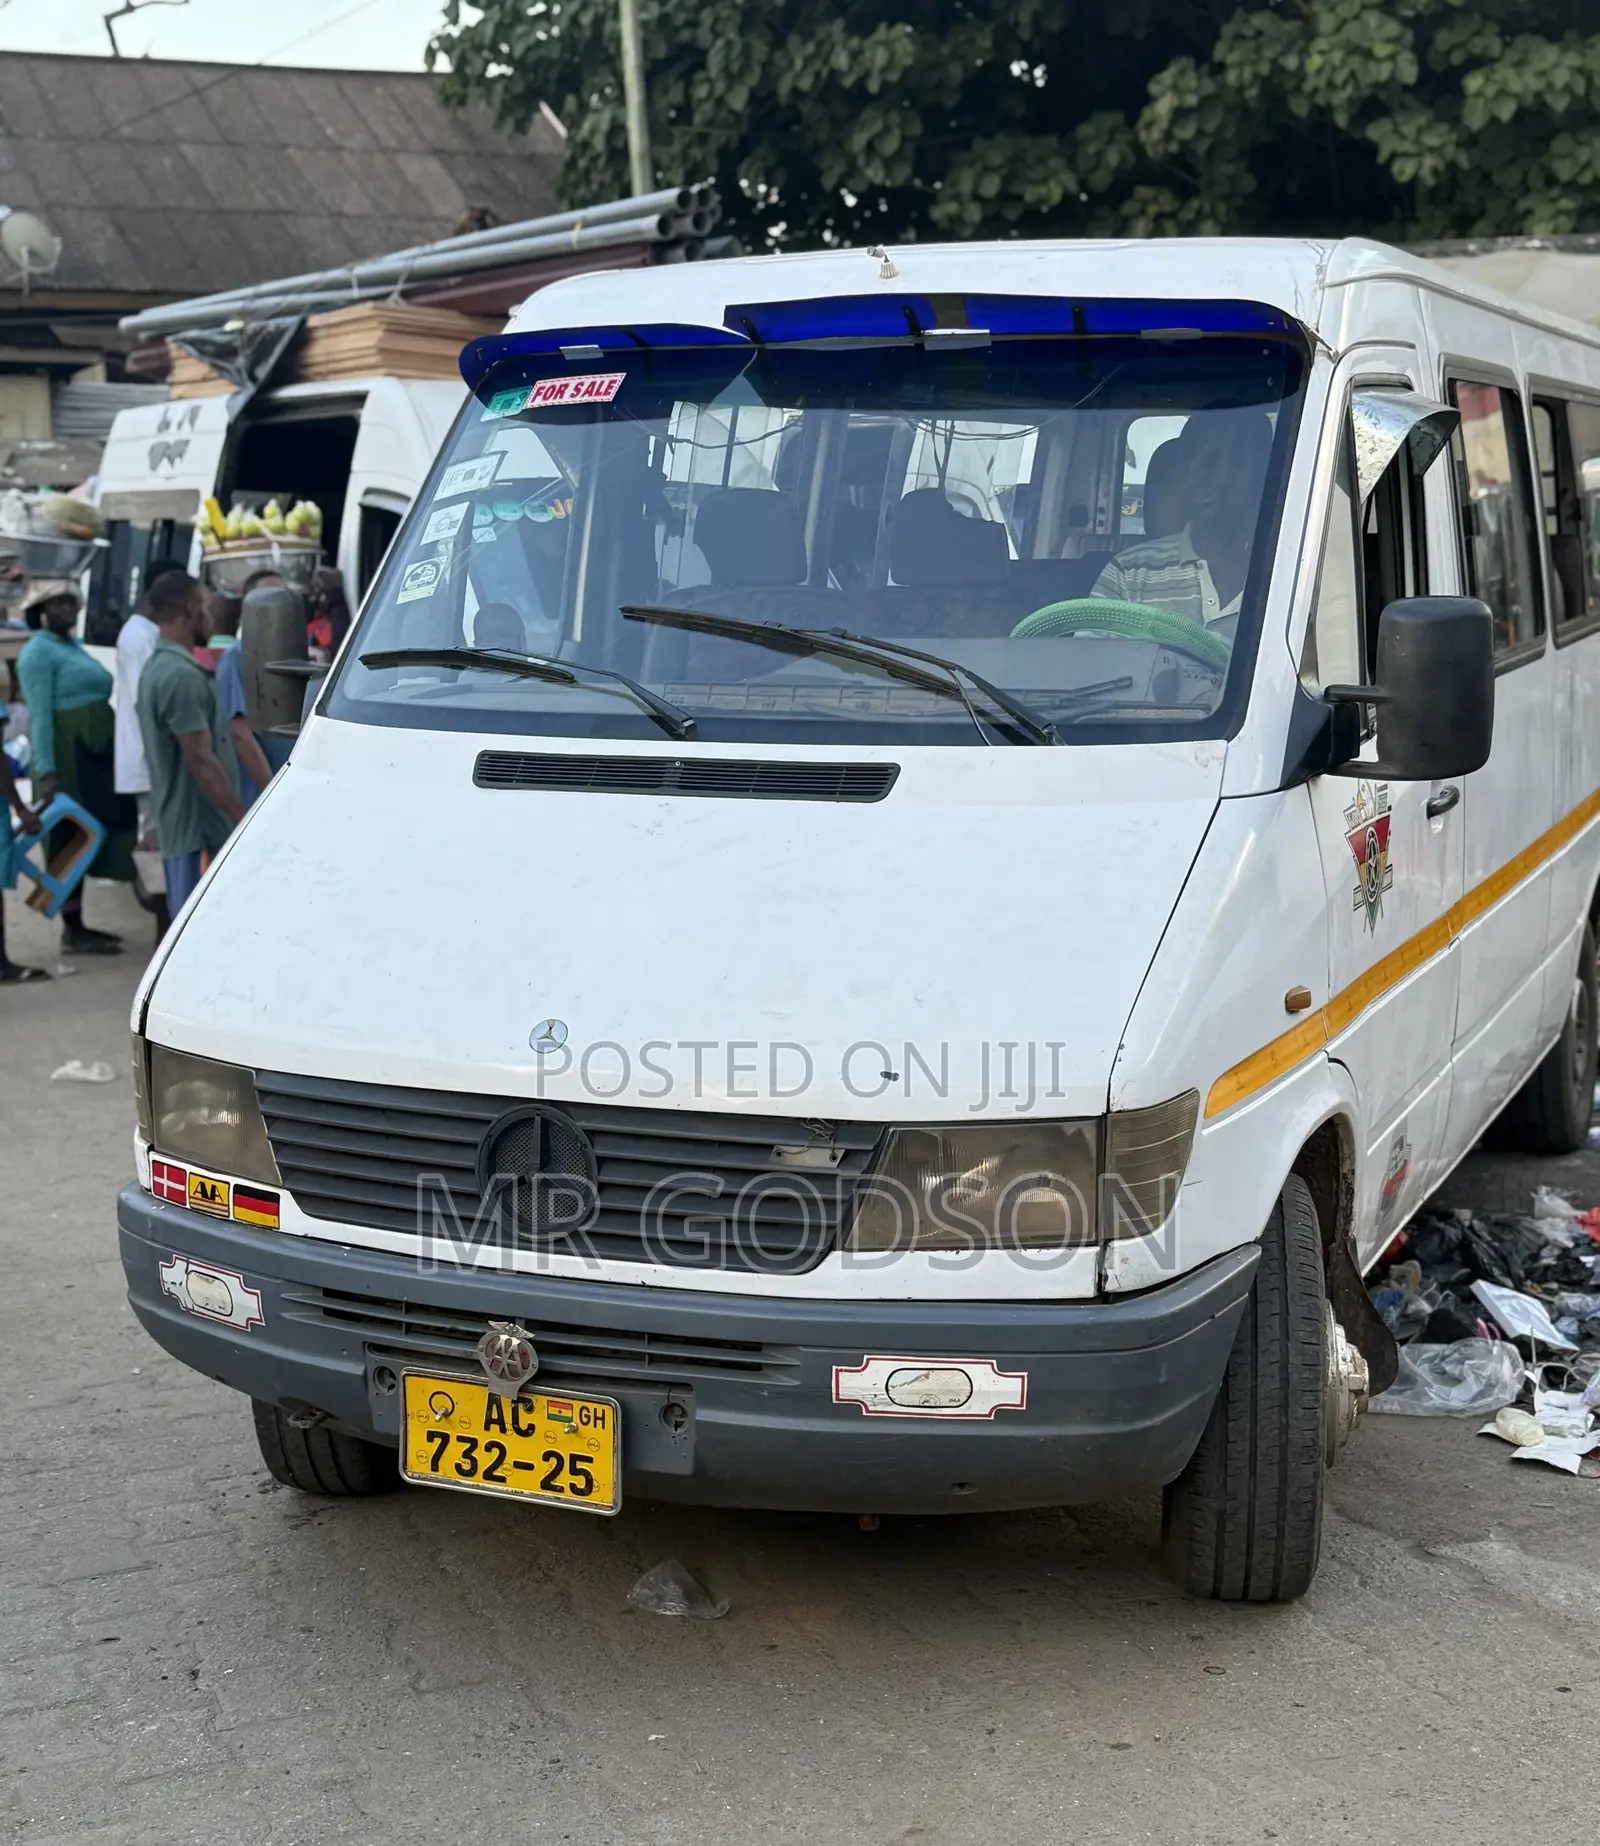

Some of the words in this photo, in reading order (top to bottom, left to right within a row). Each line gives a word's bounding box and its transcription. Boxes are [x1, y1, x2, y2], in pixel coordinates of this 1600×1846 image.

[530, 383, 569, 403] FOR
[570, 379, 617, 399] SALE
[484, 1392, 536, 1438] AC
[579, 1406, 605, 1430] GH
[426, 1429, 594, 1496] 732-25
